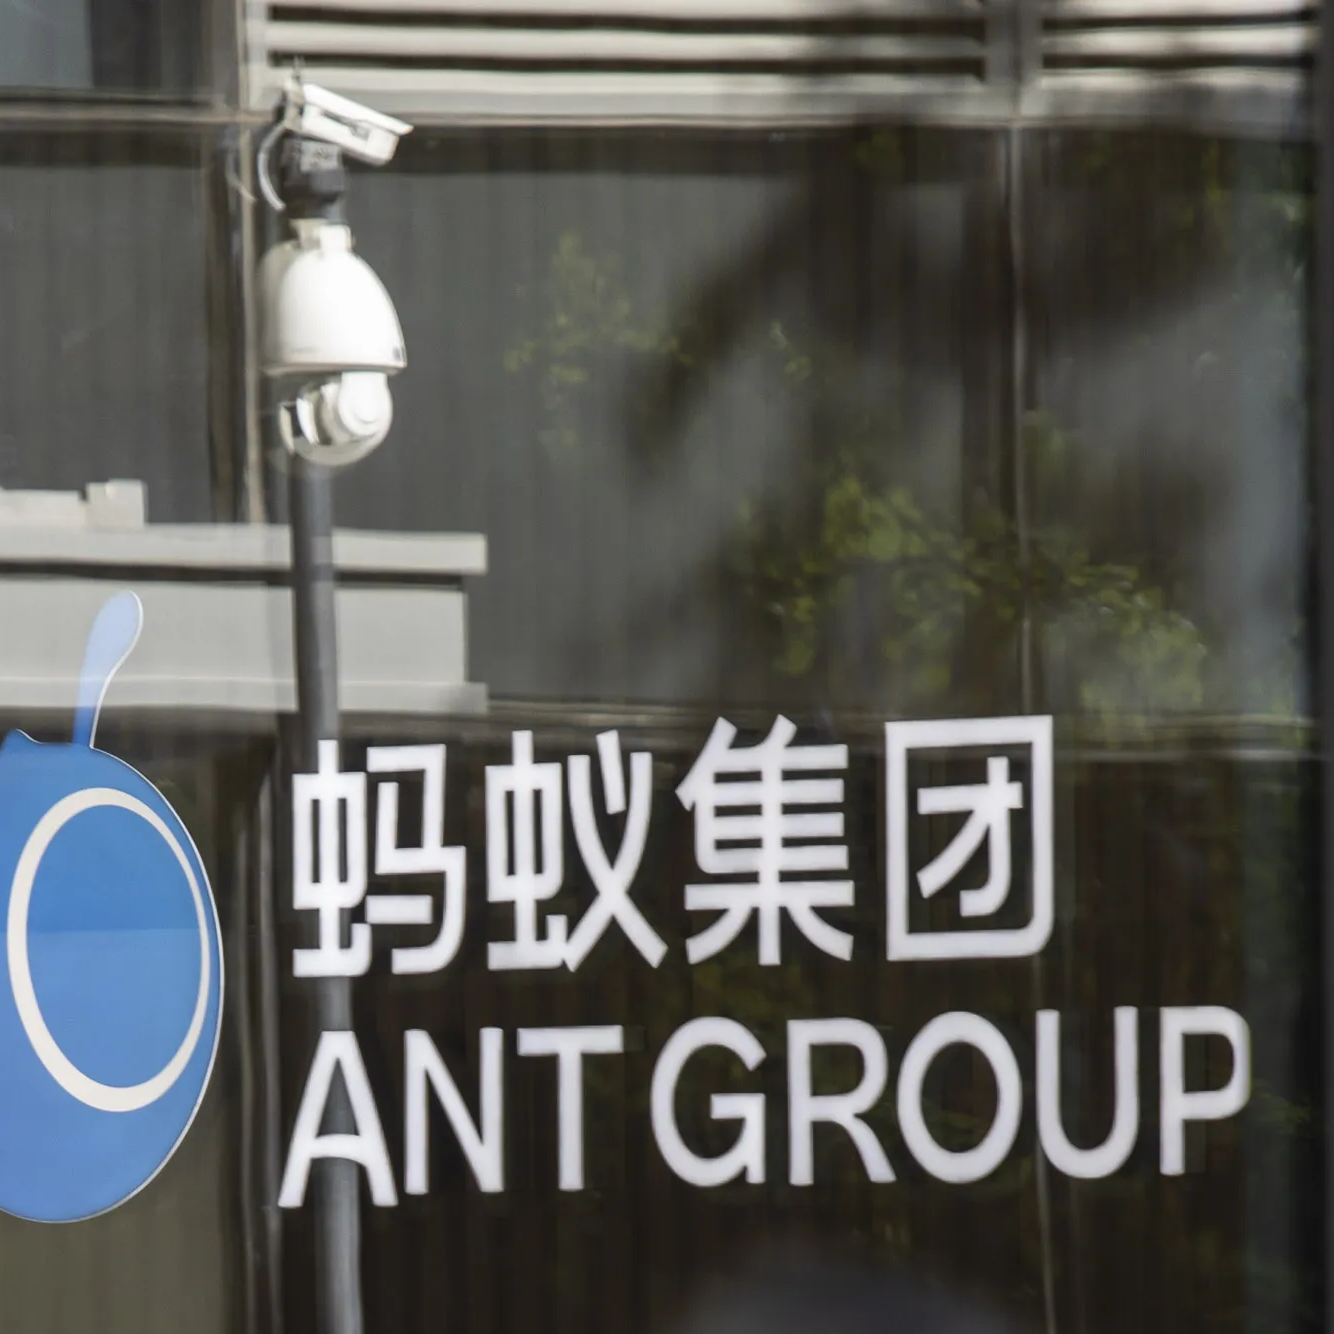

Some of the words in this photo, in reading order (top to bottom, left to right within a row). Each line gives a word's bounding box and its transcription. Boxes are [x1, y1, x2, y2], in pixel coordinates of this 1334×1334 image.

[291, 714, 1055, 978] 蚂蚁集团
[277, 1024, 624, 1209] ANT
[649, 1004, 1252, 1188] GROUP
